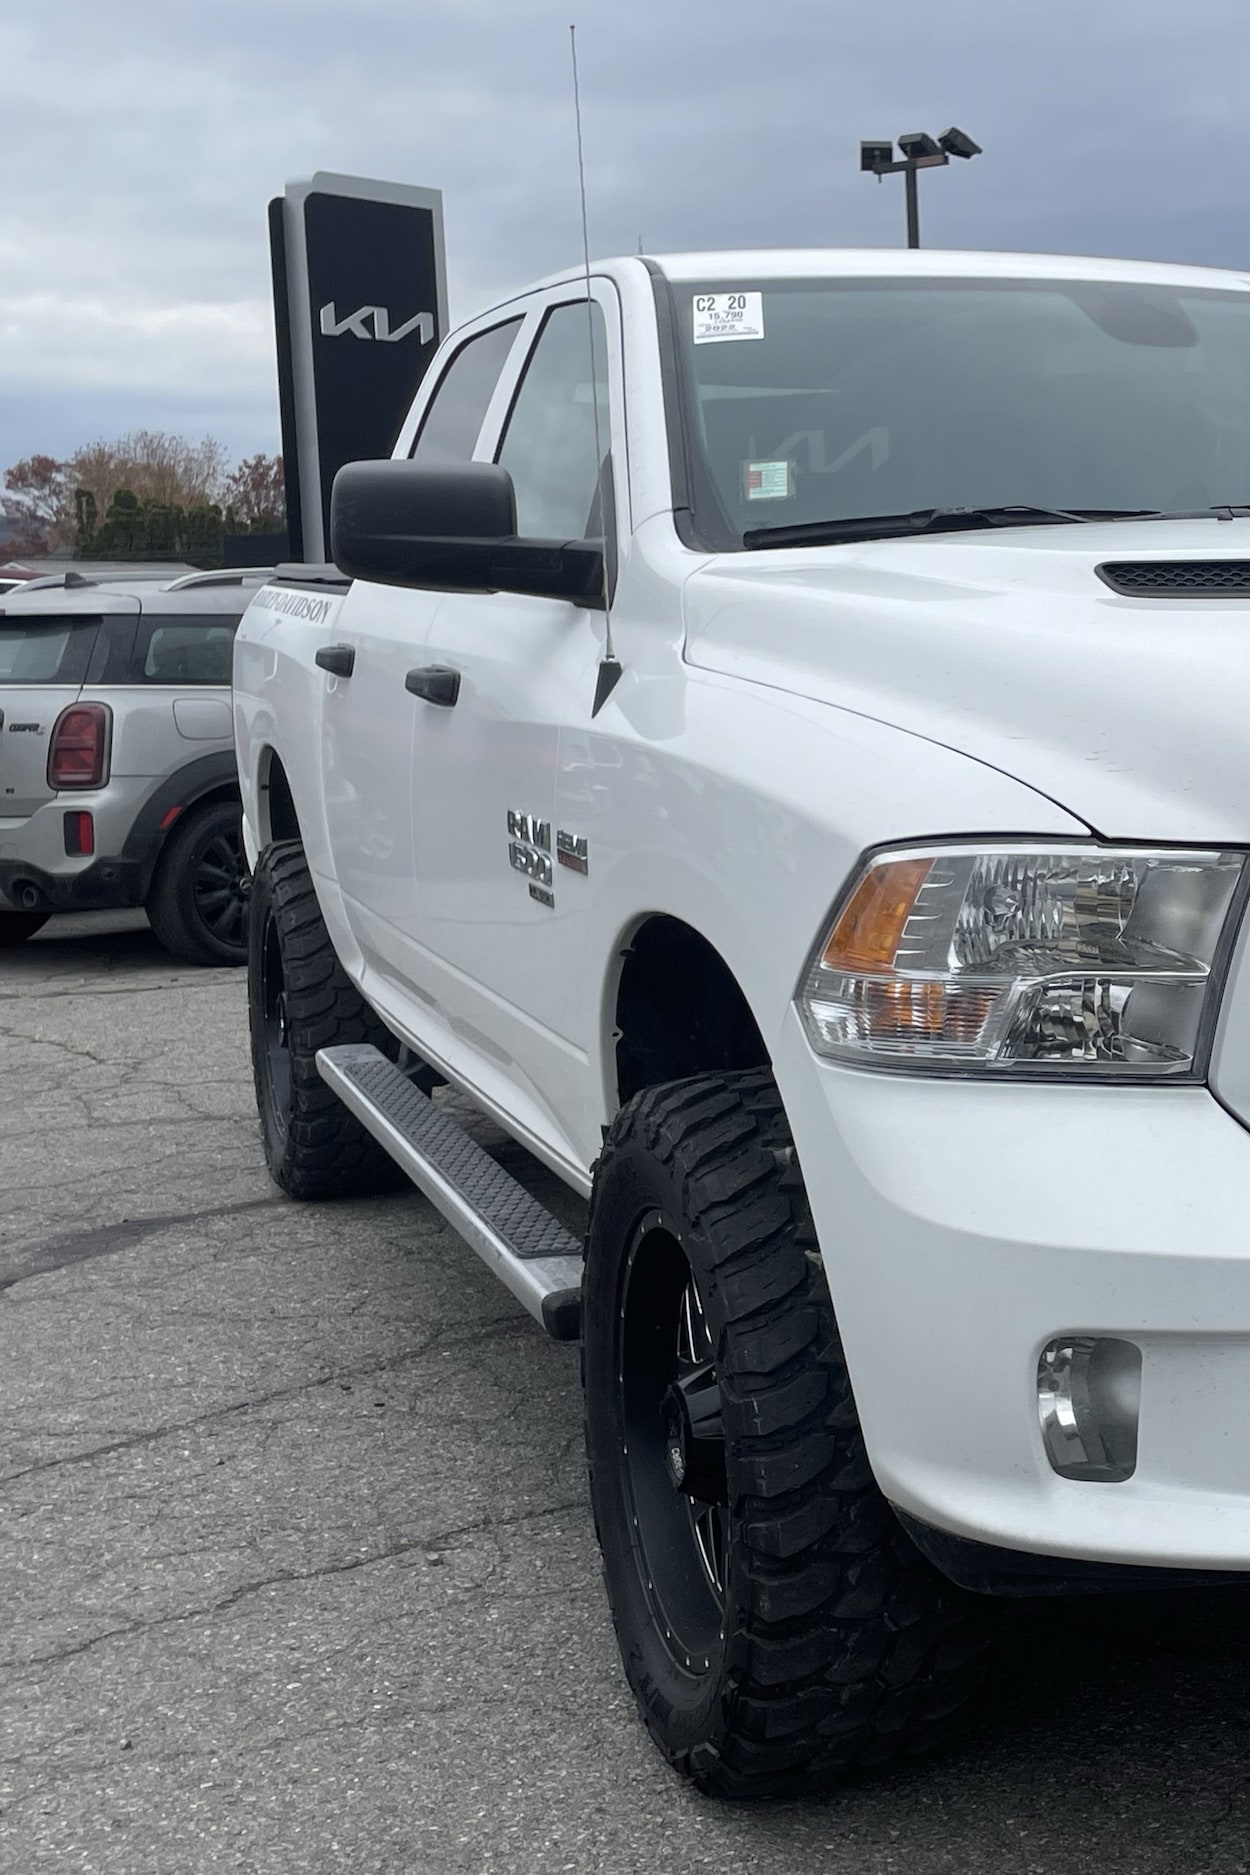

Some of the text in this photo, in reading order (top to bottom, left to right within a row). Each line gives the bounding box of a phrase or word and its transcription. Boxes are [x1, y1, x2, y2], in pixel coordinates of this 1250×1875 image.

[319, 301, 434, 346] KIA
[696, 294, 746, 312] C2 20
[507, 809, 551, 854] RAM
[508, 842, 553, 887] 1500
